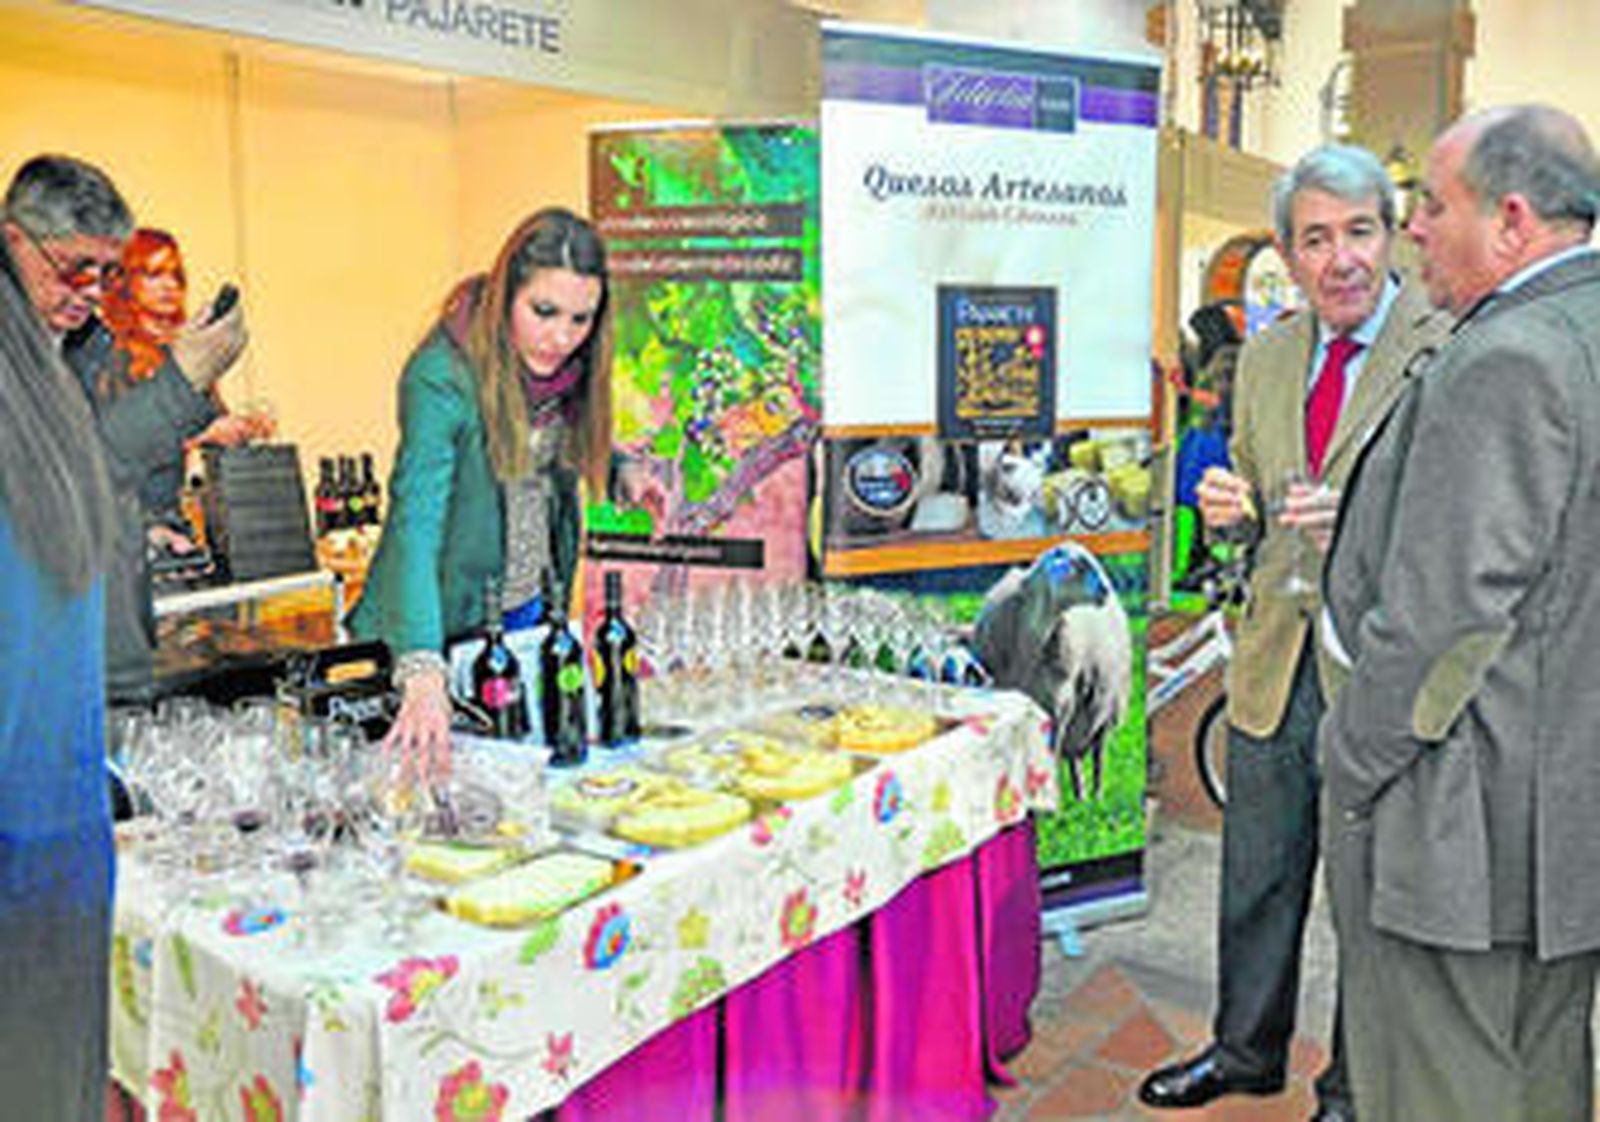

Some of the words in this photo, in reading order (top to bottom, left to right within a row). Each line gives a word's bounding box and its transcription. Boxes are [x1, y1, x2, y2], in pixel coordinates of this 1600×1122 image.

[385, 0, 561, 53] PAJARETE
[863, 164, 974, 202] Quesos
[980, 172, 1129, 207] Artesanos
